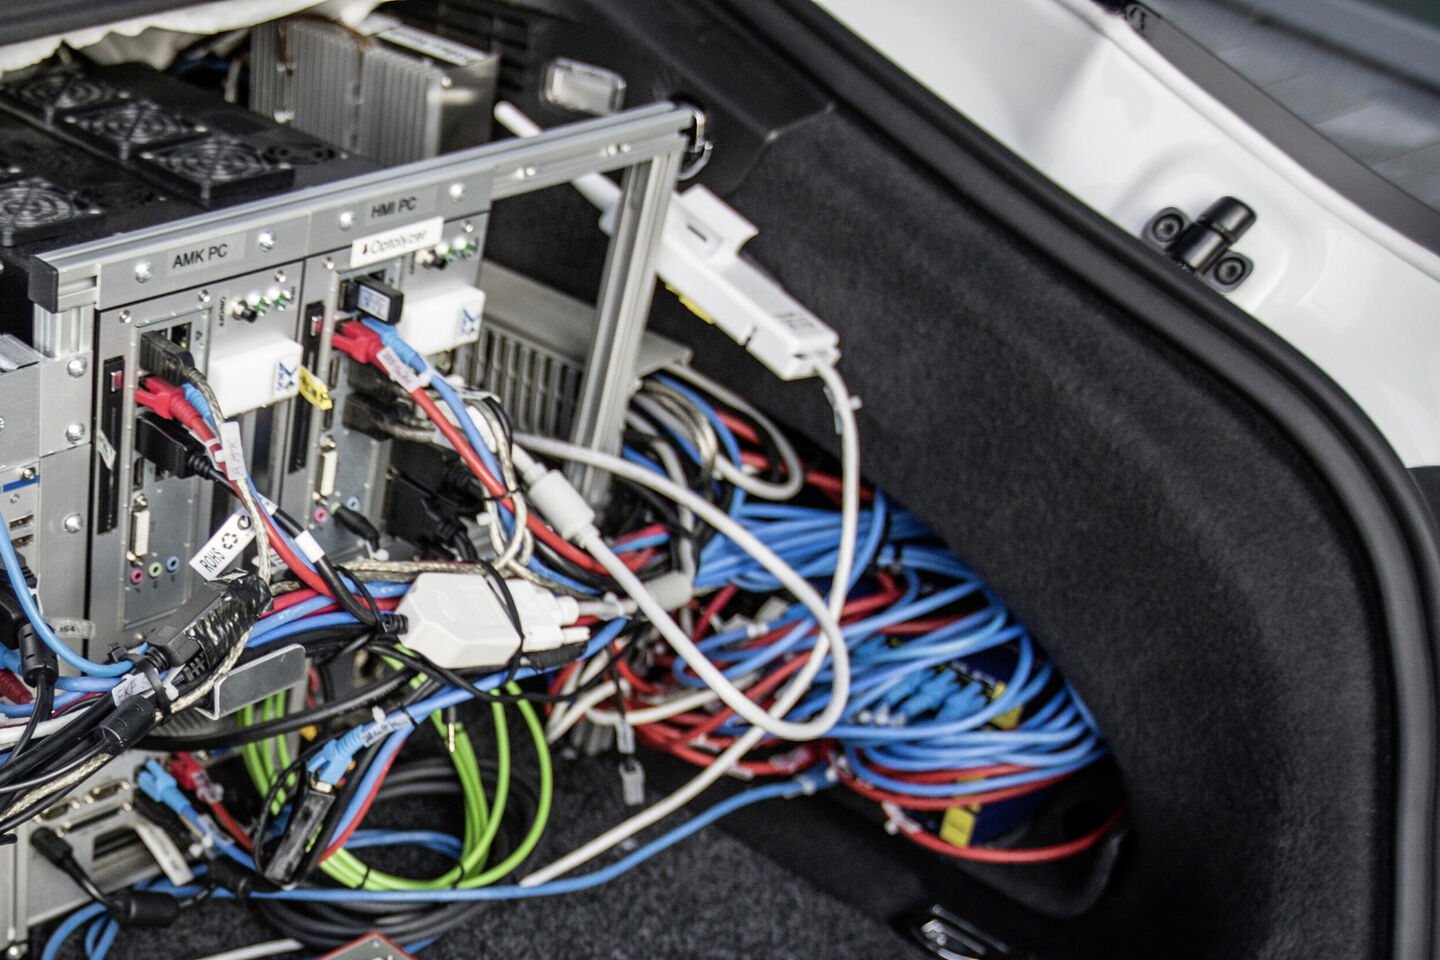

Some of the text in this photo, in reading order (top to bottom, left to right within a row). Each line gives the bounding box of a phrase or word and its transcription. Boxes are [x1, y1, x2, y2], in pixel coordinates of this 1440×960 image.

[398, 196, 417, 211] PC
[172, 244, 228, 268] AMK PC
